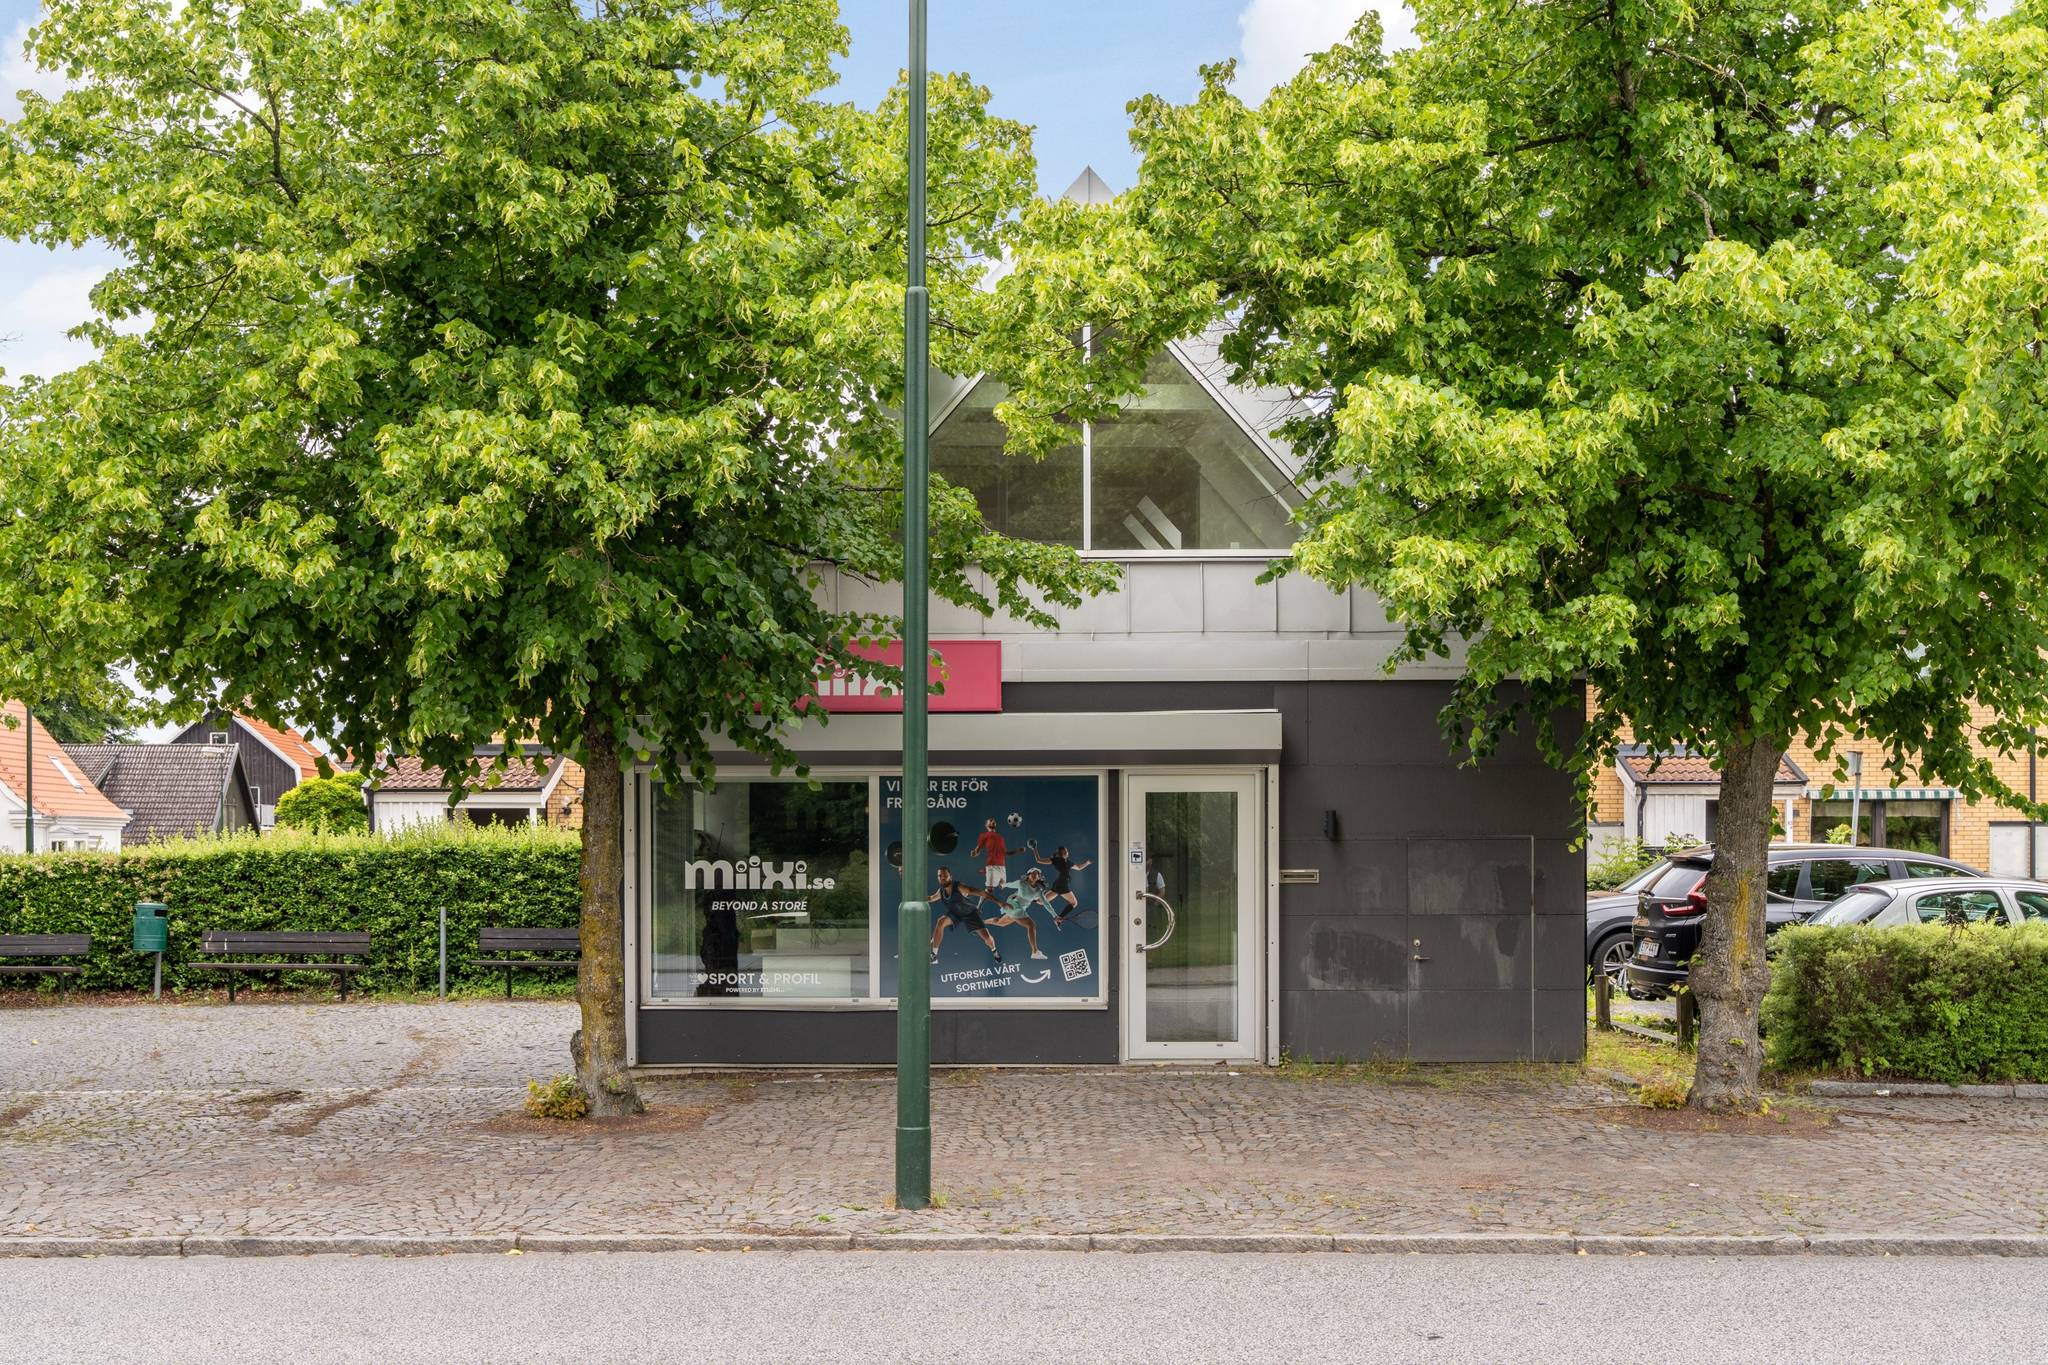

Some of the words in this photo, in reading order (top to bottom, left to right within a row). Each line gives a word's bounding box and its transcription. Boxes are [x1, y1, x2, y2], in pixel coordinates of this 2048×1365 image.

[886, 780, 900, 792] VI
[941, 780, 958, 792] ER
[961, 777, 989, 792] FÖR
[886, 793, 968, 809] FRGÅNG
[684, 855, 836, 890] miixi.se
[711, 900, 758, 911] BEYOND
[759, 900, 769, 911] A
[771, 900, 808, 911] STORE
[708, 972, 756, 985] SPORT
[759, 972, 770, 985] &
[774, 972, 822, 985] PROFIL
[940, 967, 993, 983] UTFORSKA
[993, 962, 1021, 975] VÅRT
[955, 976, 1012, 993] SORTIMENT
